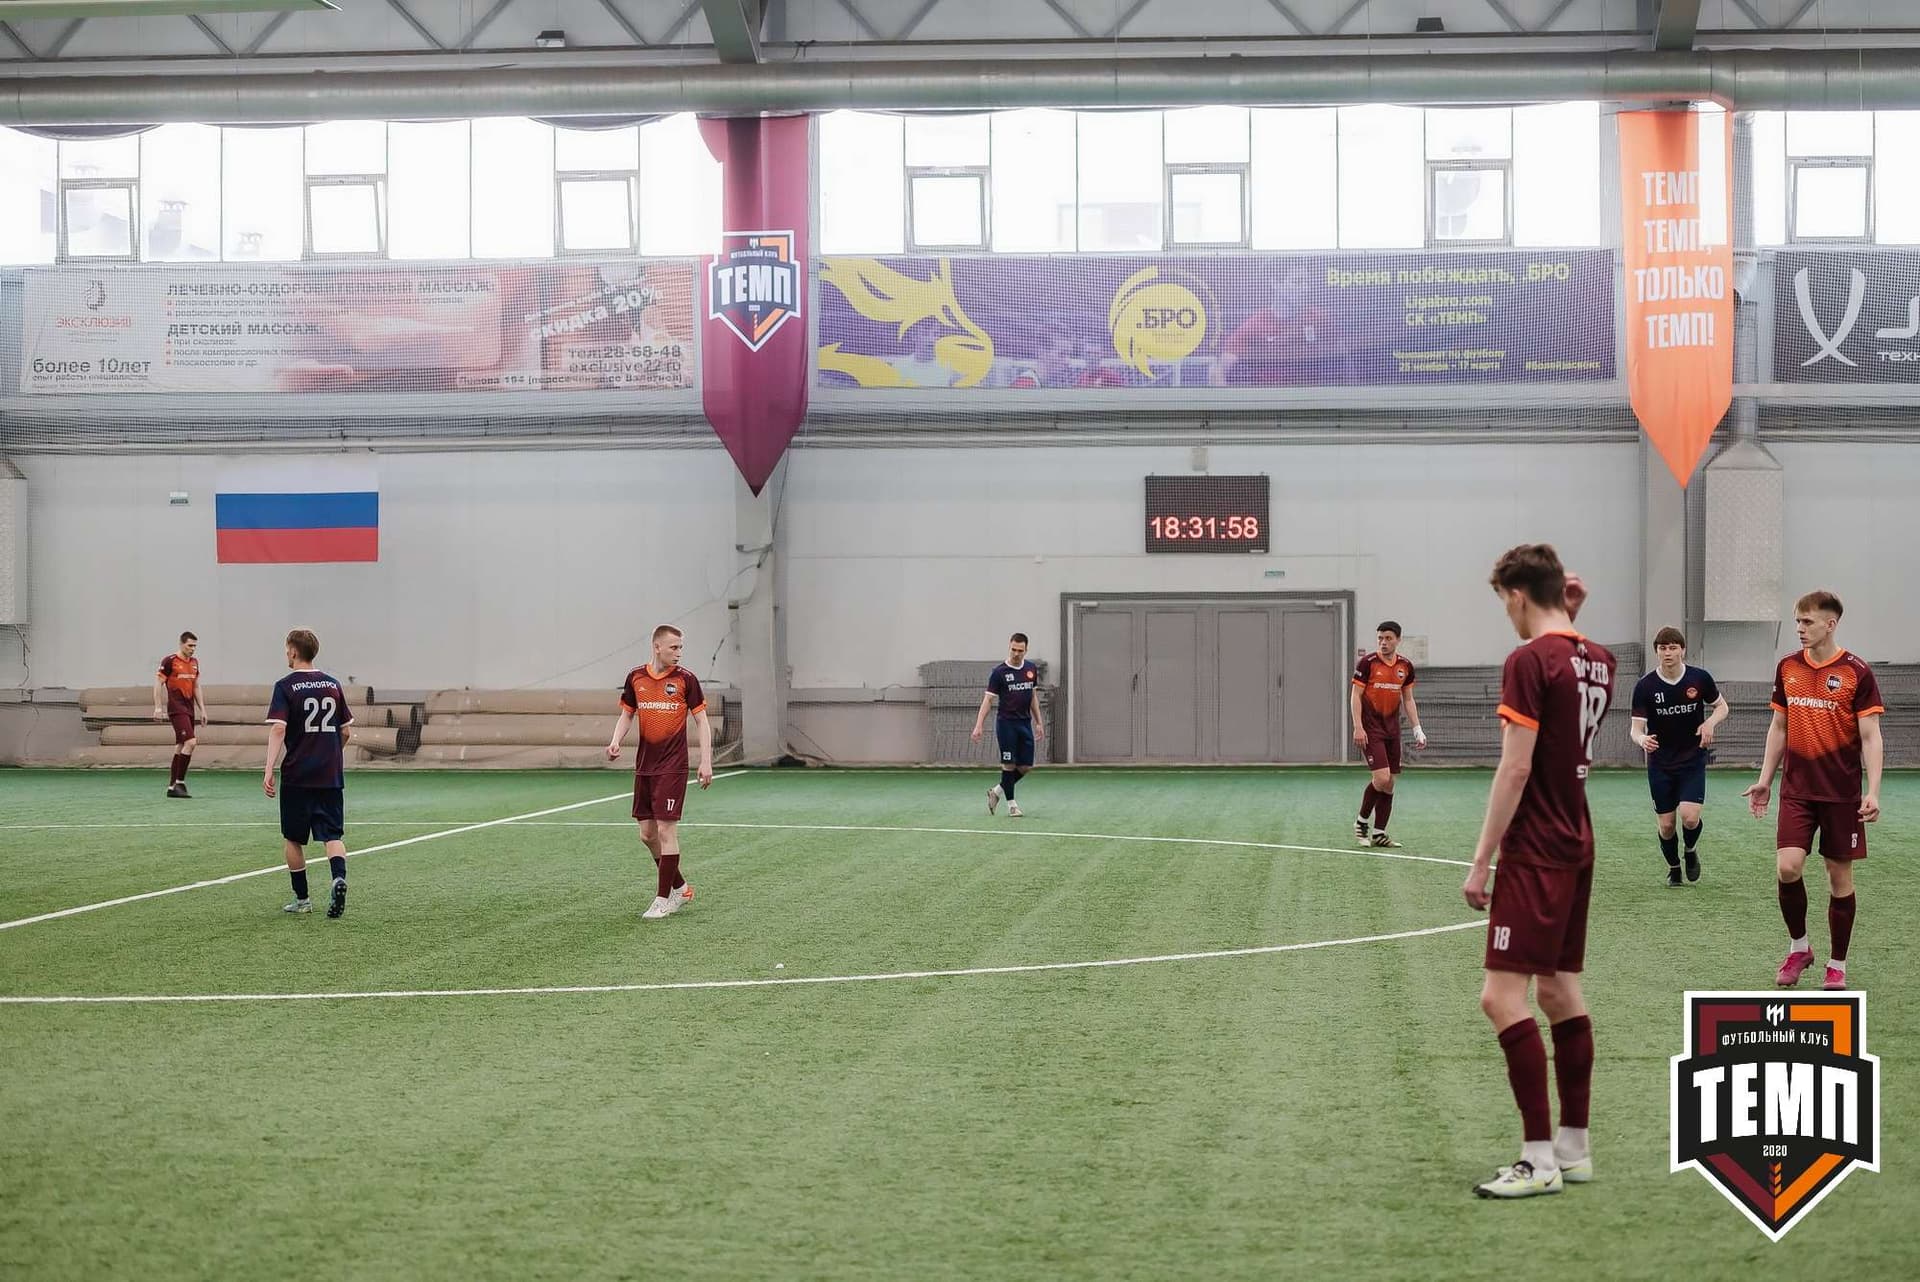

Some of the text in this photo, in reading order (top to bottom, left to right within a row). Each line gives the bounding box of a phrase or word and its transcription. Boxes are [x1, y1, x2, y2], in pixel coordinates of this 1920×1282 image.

[718, 265, 792, 306] ТЕМП
[1327, 267, 1391, 290] Время
[1397, 265, 1515, 285] побеждать,
[1633, 265, 1725, 303] ТОЛЬКО
[167, 280, 412, 297] ЛЕЧЕБНО-ОЗДОРОВИТЕЛЬНЫЙ
[1405, 295, 1493, 310] Ligabro.com
[529, 284, 664, 341] скидка 20%
[1136, 309, 1197, 328] .БРО
[1405, 313, 1427, 326] СК
[167, 320, 242, 337] ДЕТСКИЙ
[1645, 311, 1715, 349] ТЕМП!
[33, 358, 151, 373] более 10лет
[1151, 516, 1259, 539] 18:31:58
[1654, 692, 1665, 704] 31
[303, 697, 337, 733] 22
[1656, 703, 1698, 716] РАССВЕТ
[667, 798, 675, 811] 17
[1493, 925, 1511, 951] 18
